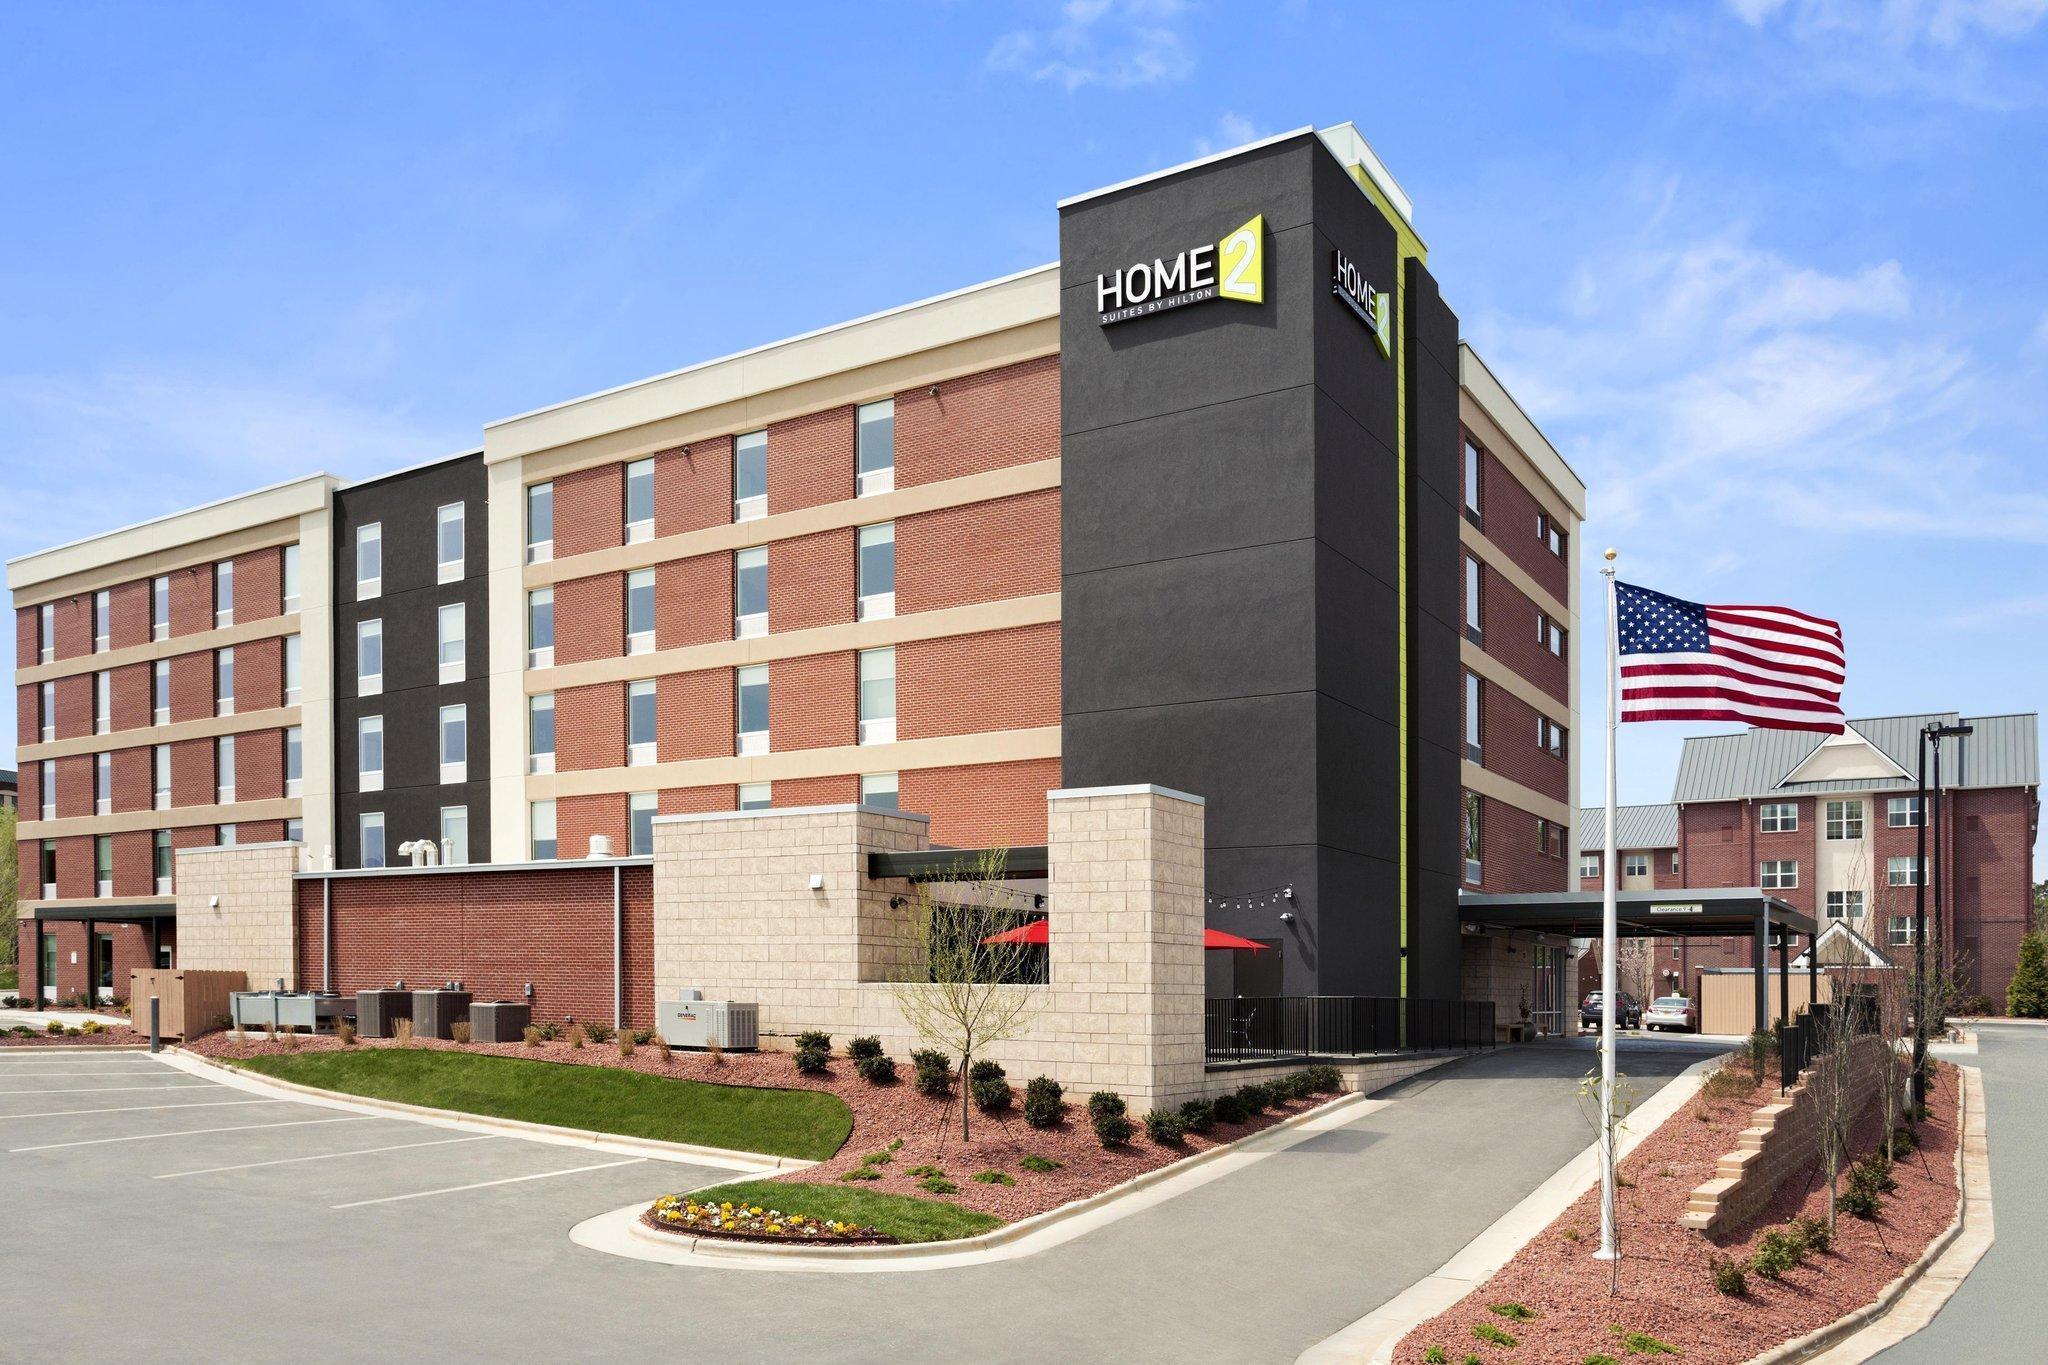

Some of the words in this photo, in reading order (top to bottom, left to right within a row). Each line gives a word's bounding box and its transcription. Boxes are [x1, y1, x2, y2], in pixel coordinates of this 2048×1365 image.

[1098, 244, 1214, 312] HOME
[1224, 229, 1257, 295] 2
[1102, 306, 1143, 323] SUITES
[1148, 301, 1163, 312] BY
[1168, 288, 1212, 307] HILTON
[1337, 249, 1376, 320] HOME
